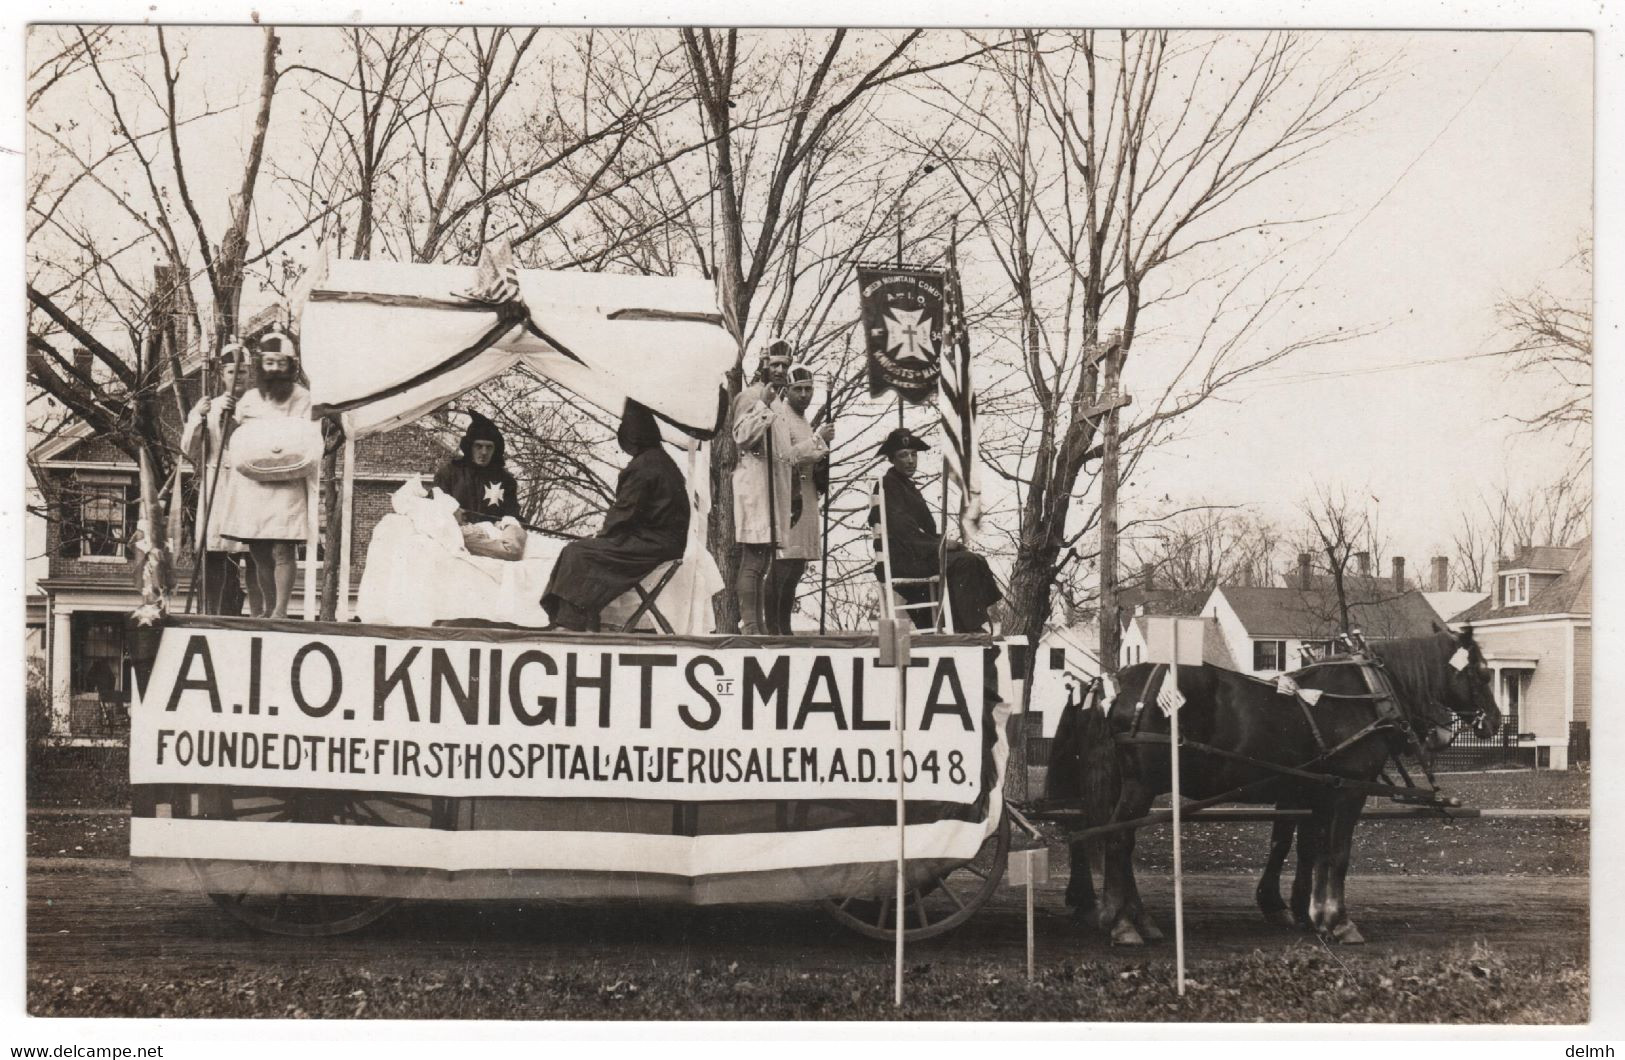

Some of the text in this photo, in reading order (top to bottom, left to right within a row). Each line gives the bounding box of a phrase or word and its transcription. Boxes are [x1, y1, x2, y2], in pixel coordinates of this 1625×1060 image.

[373, 645, 726, 731] KNIGHTS
[716, 683, 733, 694] OF
[157, 730, 301, 771] FOUNDED
[302, 735, 366, 774] THE
[374, 740, 460, 779] FIRST
[465, 744, 609, 782] HOSPITAL
[612, 746, 648, 782] AT
